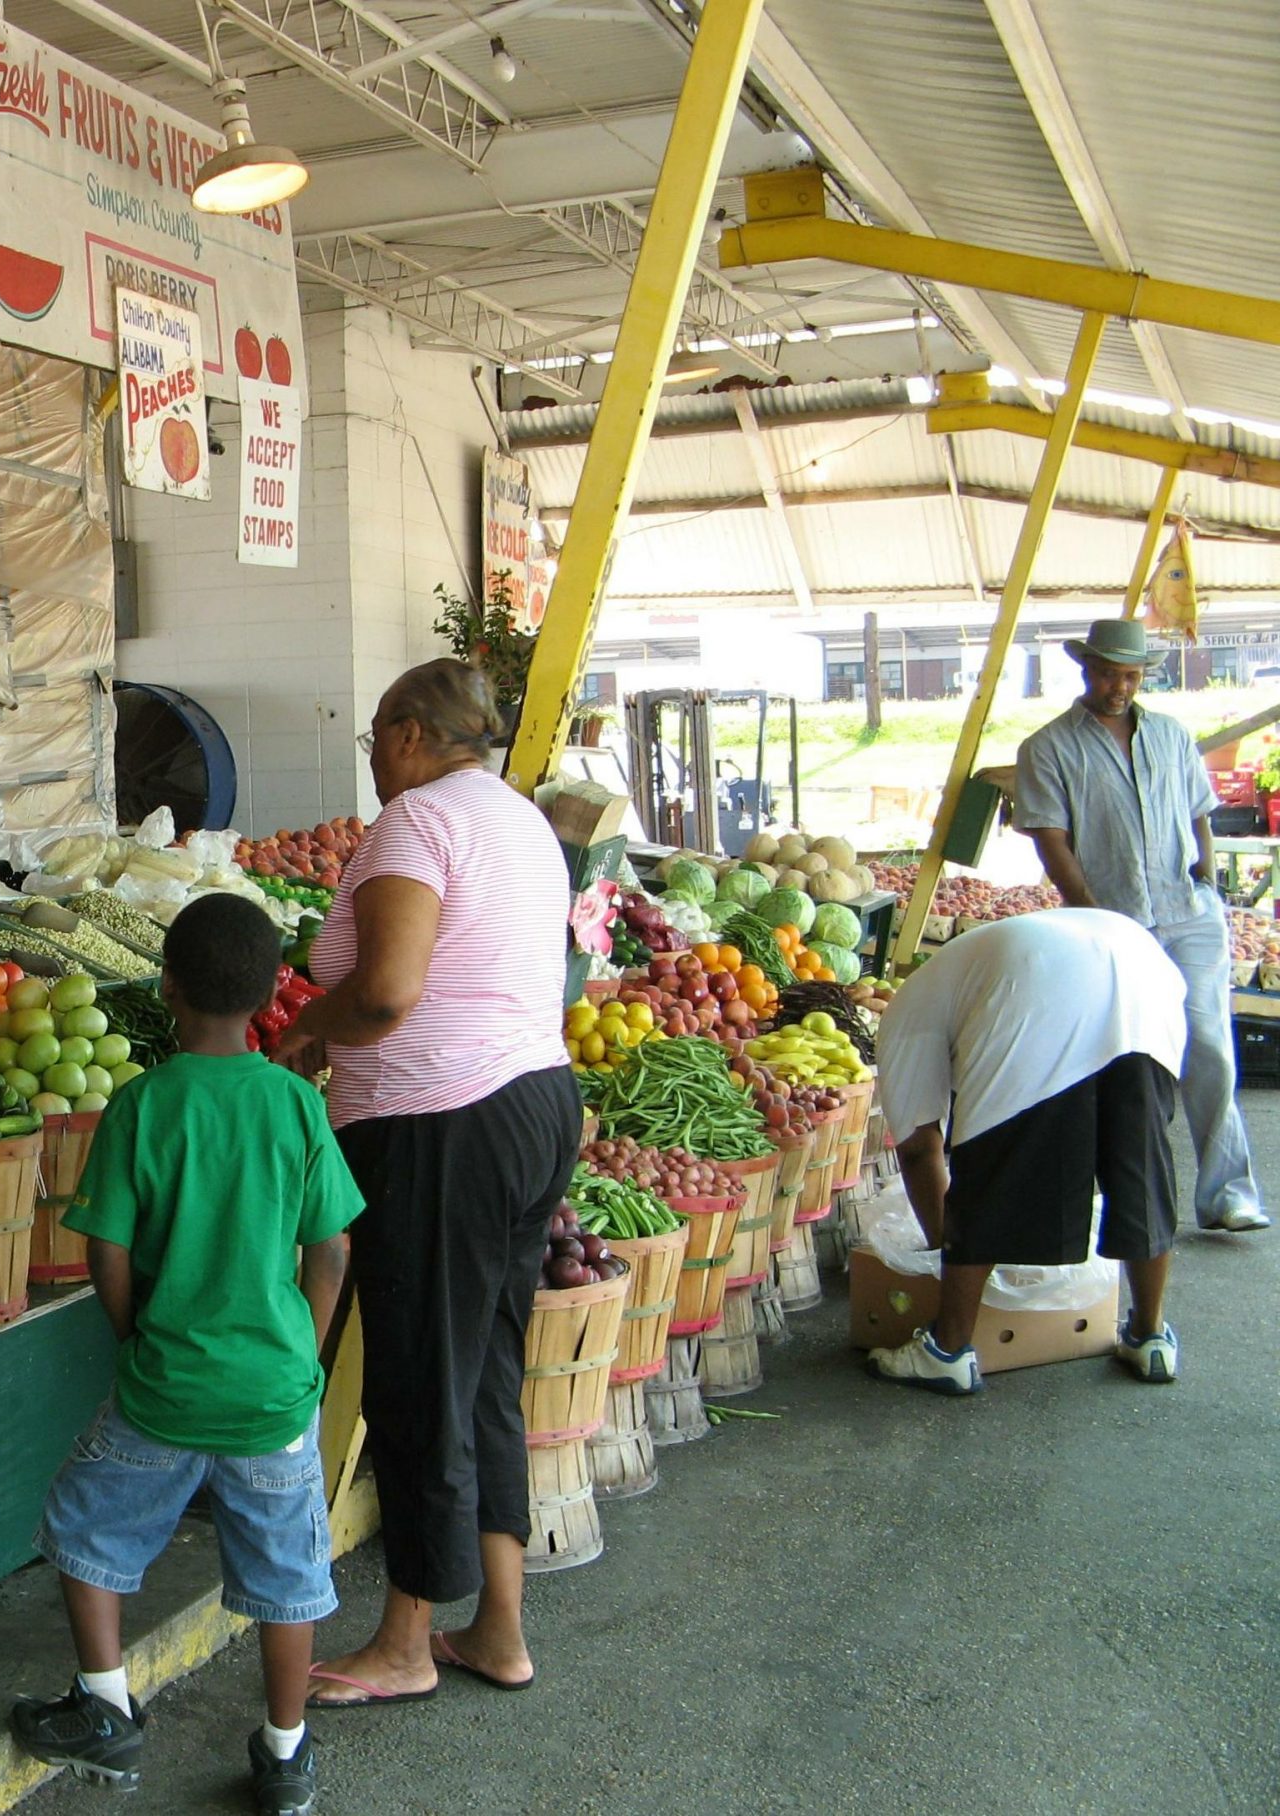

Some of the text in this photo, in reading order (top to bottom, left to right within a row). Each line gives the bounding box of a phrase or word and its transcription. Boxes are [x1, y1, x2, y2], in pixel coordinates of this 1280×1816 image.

[57, 68, 140, 171] FRUITS
[145, 115, 163, 187] &
[151, 199, 203, 261] County
[105, 254, 198, 310] DORIS BERRY
[122, 298, 192, 356] Chilton County
[121, 338, 166, 375] ALABAMA
[259, 398, 281, 429] WE
[247, 434, 296, 472] ACCEPT
[252, 476, 285, 510] FOOD
[243, 514, 294, 550] STAMPS
[1204, 633, 1249, 646] SERVICE
